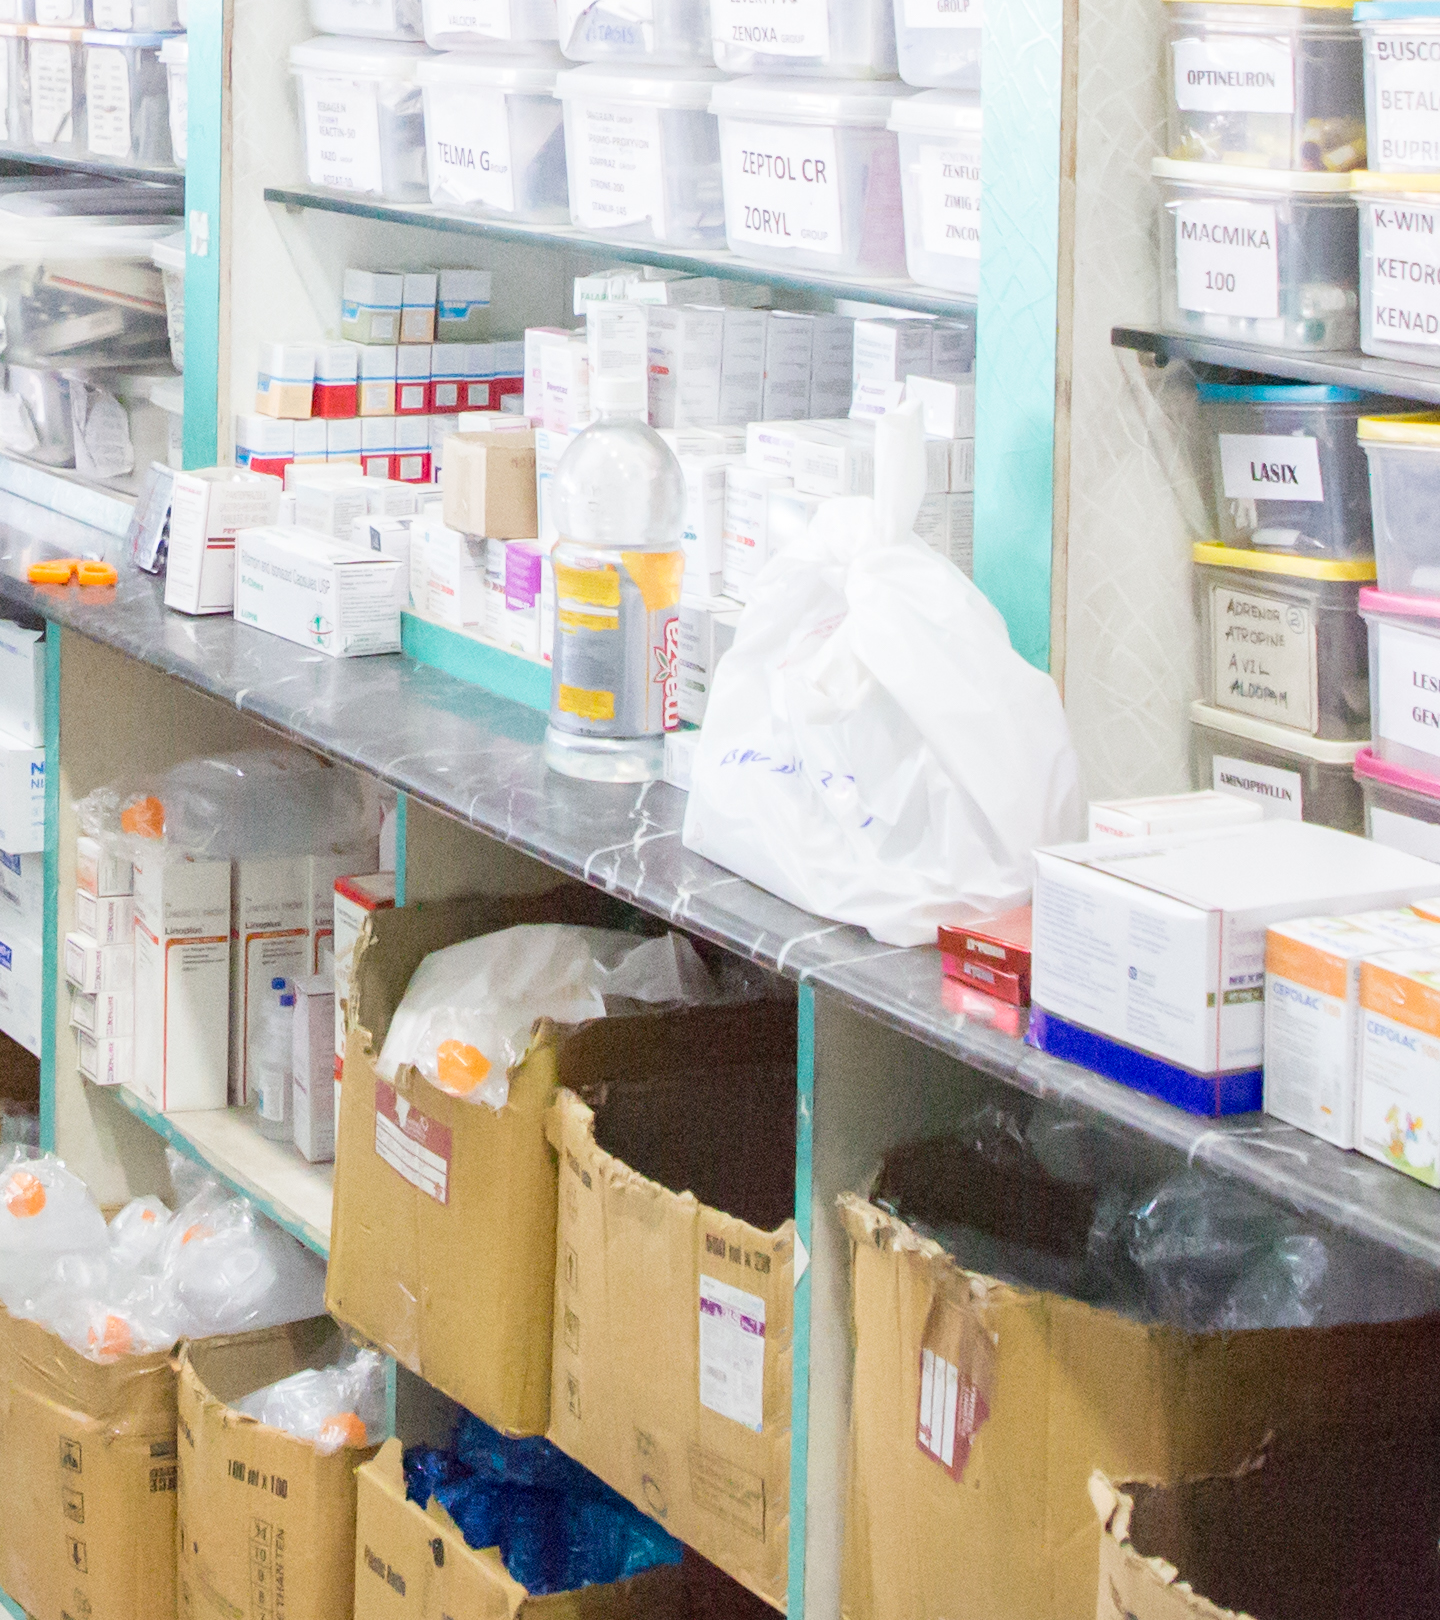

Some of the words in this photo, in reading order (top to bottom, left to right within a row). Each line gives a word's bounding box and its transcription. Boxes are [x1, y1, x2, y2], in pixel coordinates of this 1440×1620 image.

[732, 25, 778, 43] ZENOXA
[1186, 68, 1276, 88] OPTINEURON
[437, 142, 475, 168] TELMA
[741, 150, 796, 182] ZEPTOL
[801, 158, 828, 183] CR
[744, 205, 792, 236] ZORYL
[1375, 208, 1435, 235] K-WIN
[1180, 220, 1271, 250] MACMIKA
[1204, 269, 1236, 292] 100
[1249, 460, 1299, 486] LASIX
[319, 575, 331, 595] USP
[1225, 624, 1285, 648] ATROPINE
[1220, 771, 1292, 802] AMINOPHYLLIN
[1271, 981, 1319, 1012] CEFOLAC
[1366, 1017, 1418, 1054] CEFOLAC
